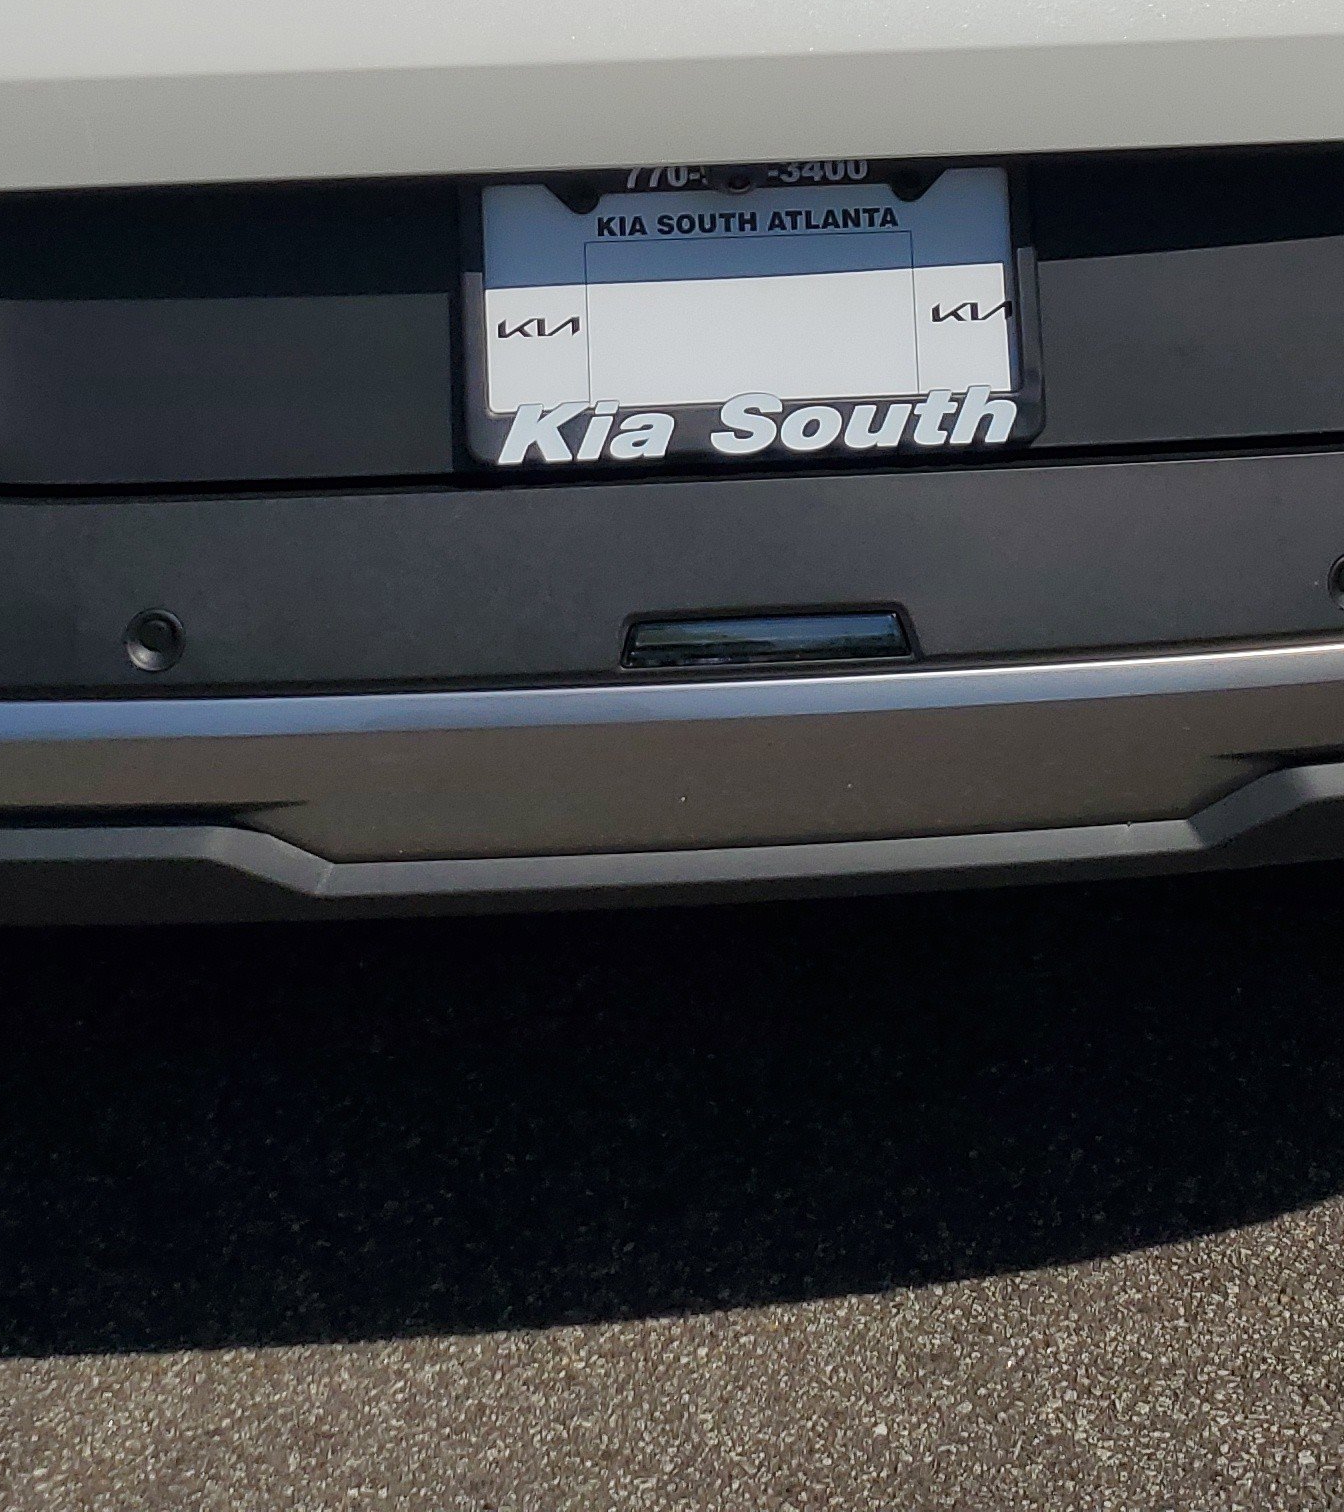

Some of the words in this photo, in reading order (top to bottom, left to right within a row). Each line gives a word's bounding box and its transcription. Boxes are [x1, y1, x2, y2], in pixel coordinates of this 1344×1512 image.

[596, 213, 647, 238] KIA
[656, 210, 757, 235] SOUTH
[767, 206, 899, 232] ATLANTA
[497, 400, 675, 466] Kia
[710, 385, 1018, 454] South
